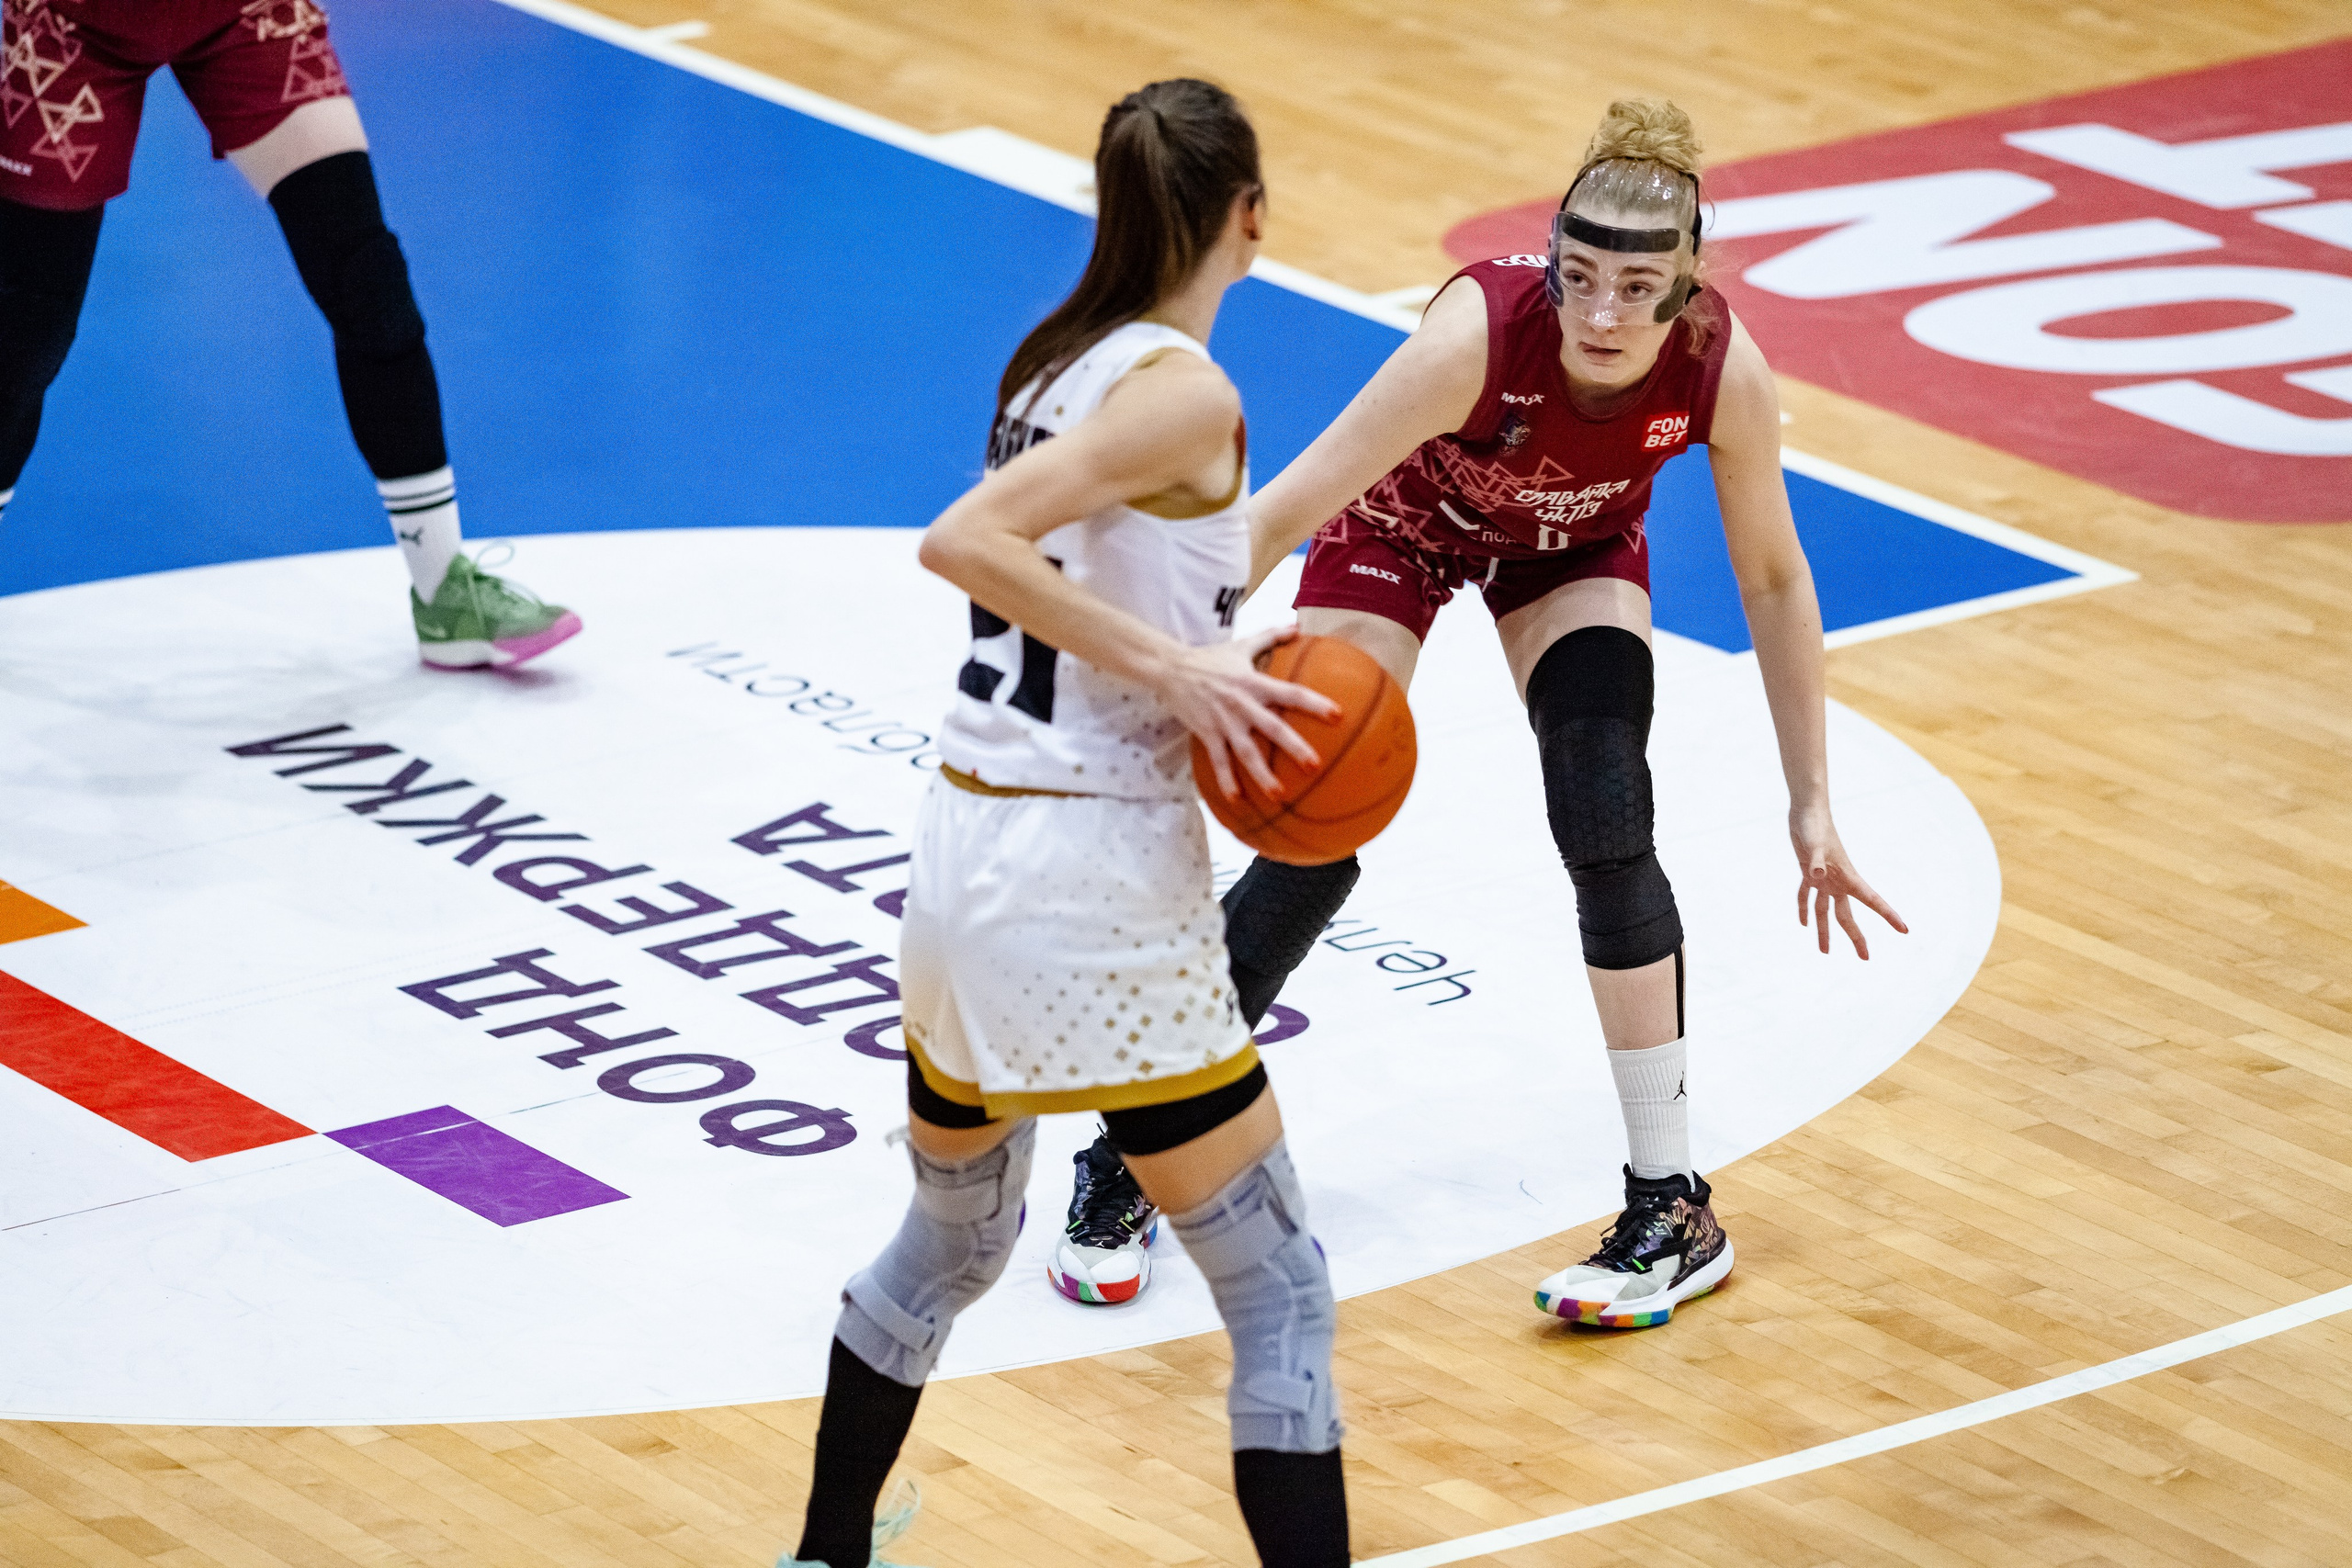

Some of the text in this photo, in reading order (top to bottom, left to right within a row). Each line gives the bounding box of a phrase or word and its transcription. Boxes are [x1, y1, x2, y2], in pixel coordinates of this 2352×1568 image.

[1647, 415, 1690, 434] FON
[1644, 429, 1689, 448] BET
[1349, 563, 1402, 584] MAXX
[224, 724, 909, 1061] ДДЕРЖКИ
[398, 948, 857, 1156] ФОНД
